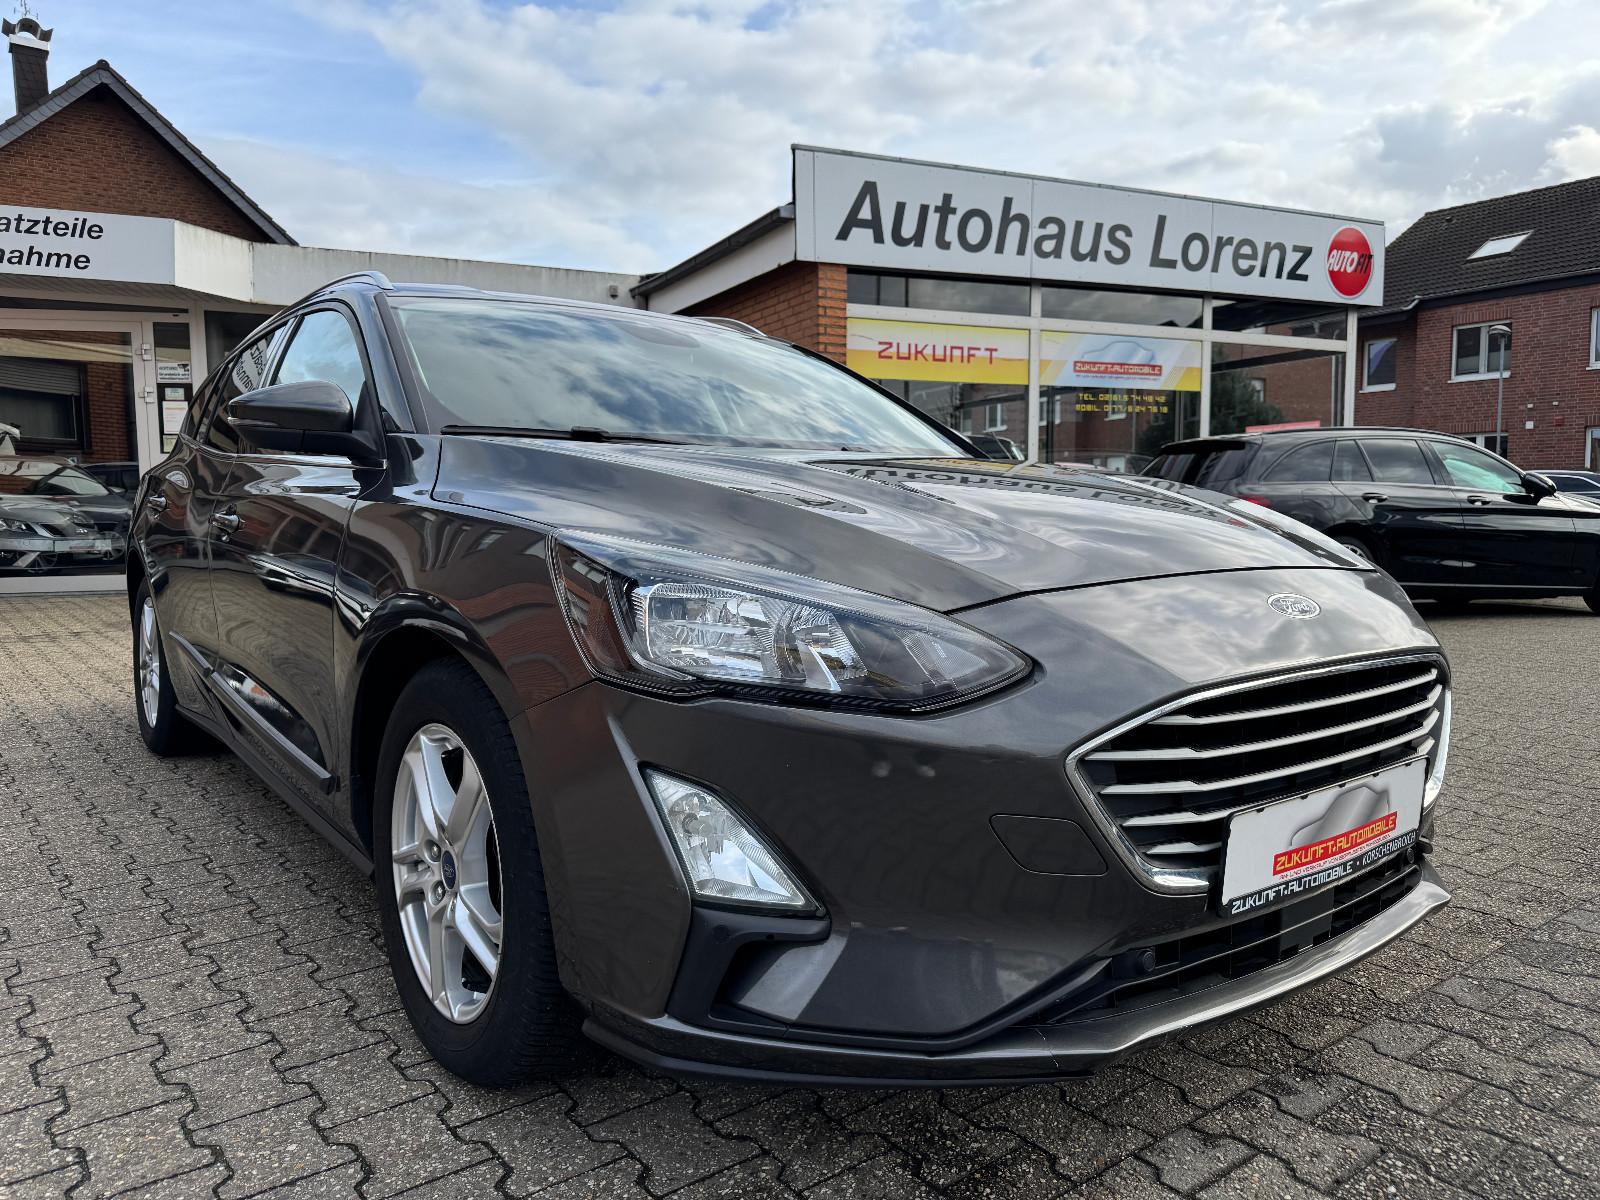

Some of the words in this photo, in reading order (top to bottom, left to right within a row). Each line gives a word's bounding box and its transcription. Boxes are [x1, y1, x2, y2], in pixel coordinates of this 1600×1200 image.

[835, 180, 1133, 265] Autohaus
[1149, 214, 1313, 282] Lorenz
[878, 341, 998, 365] ZUKUNFT
